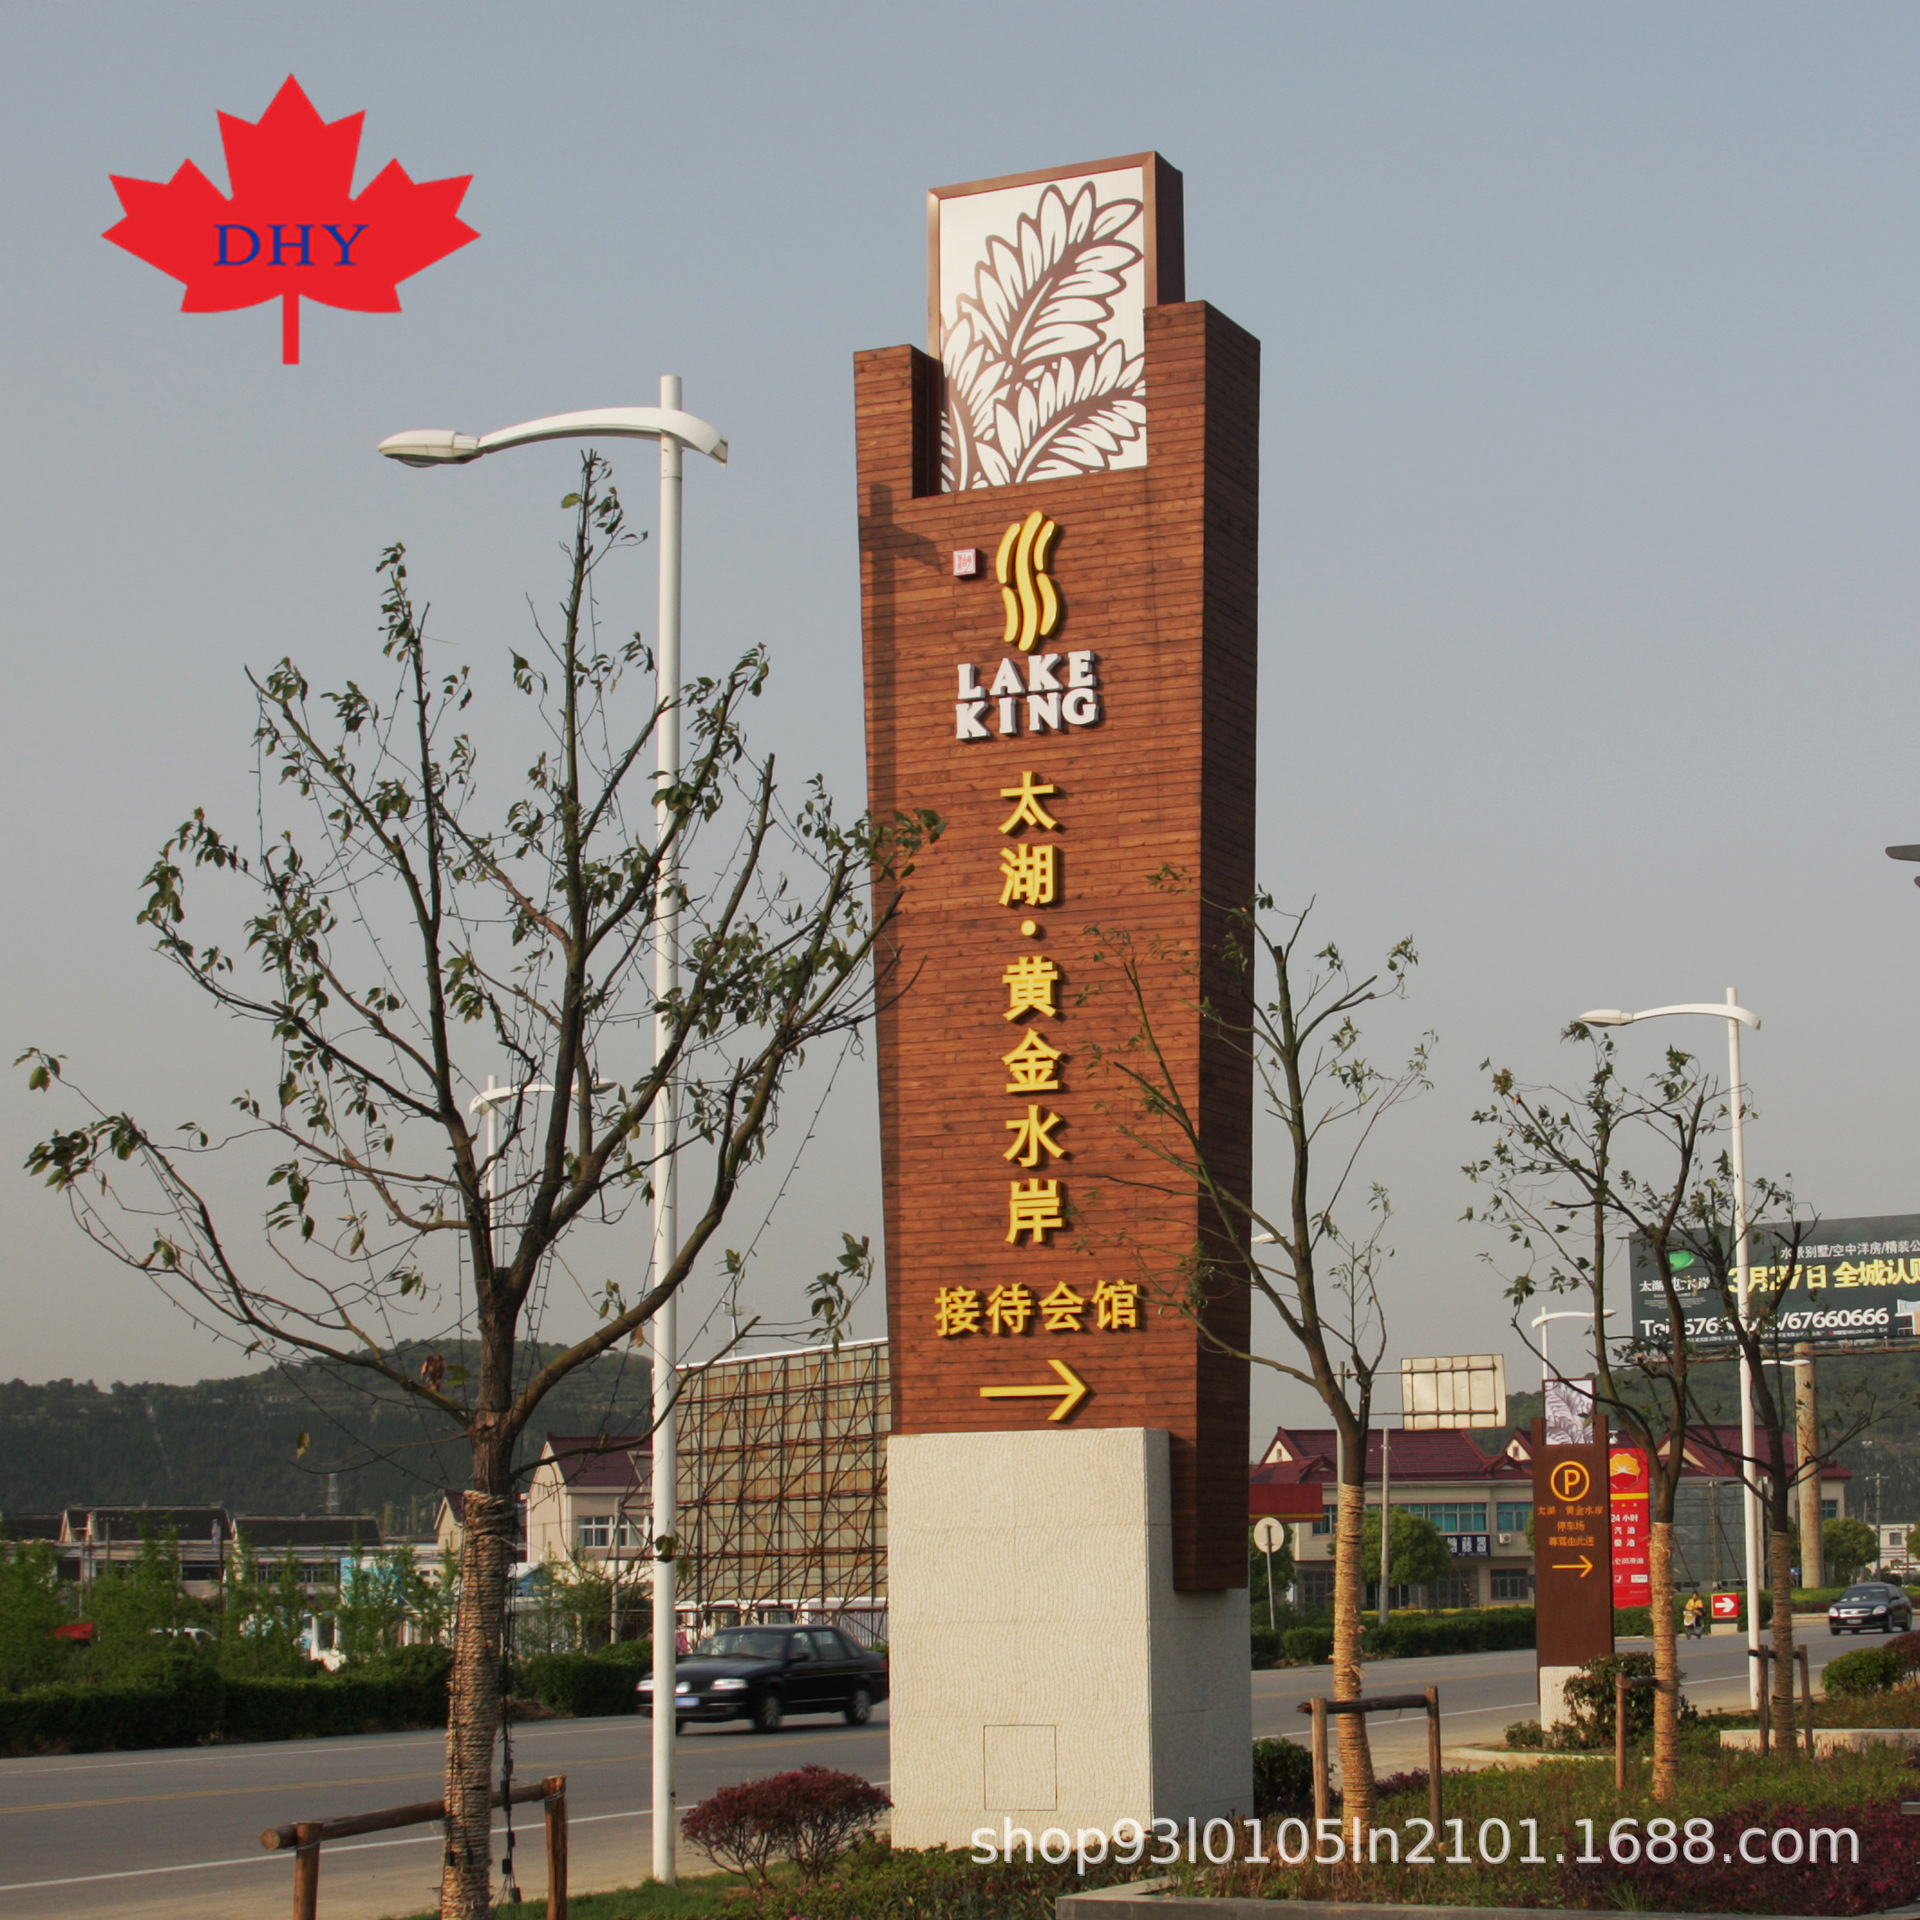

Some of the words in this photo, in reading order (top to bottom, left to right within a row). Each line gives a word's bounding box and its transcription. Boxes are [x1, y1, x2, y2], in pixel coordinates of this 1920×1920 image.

[957, 650, 1097, 700] LAKE
[955, 688, 1100, 740] KING
[934, 1278, 1140, 1337] 接待会馆
